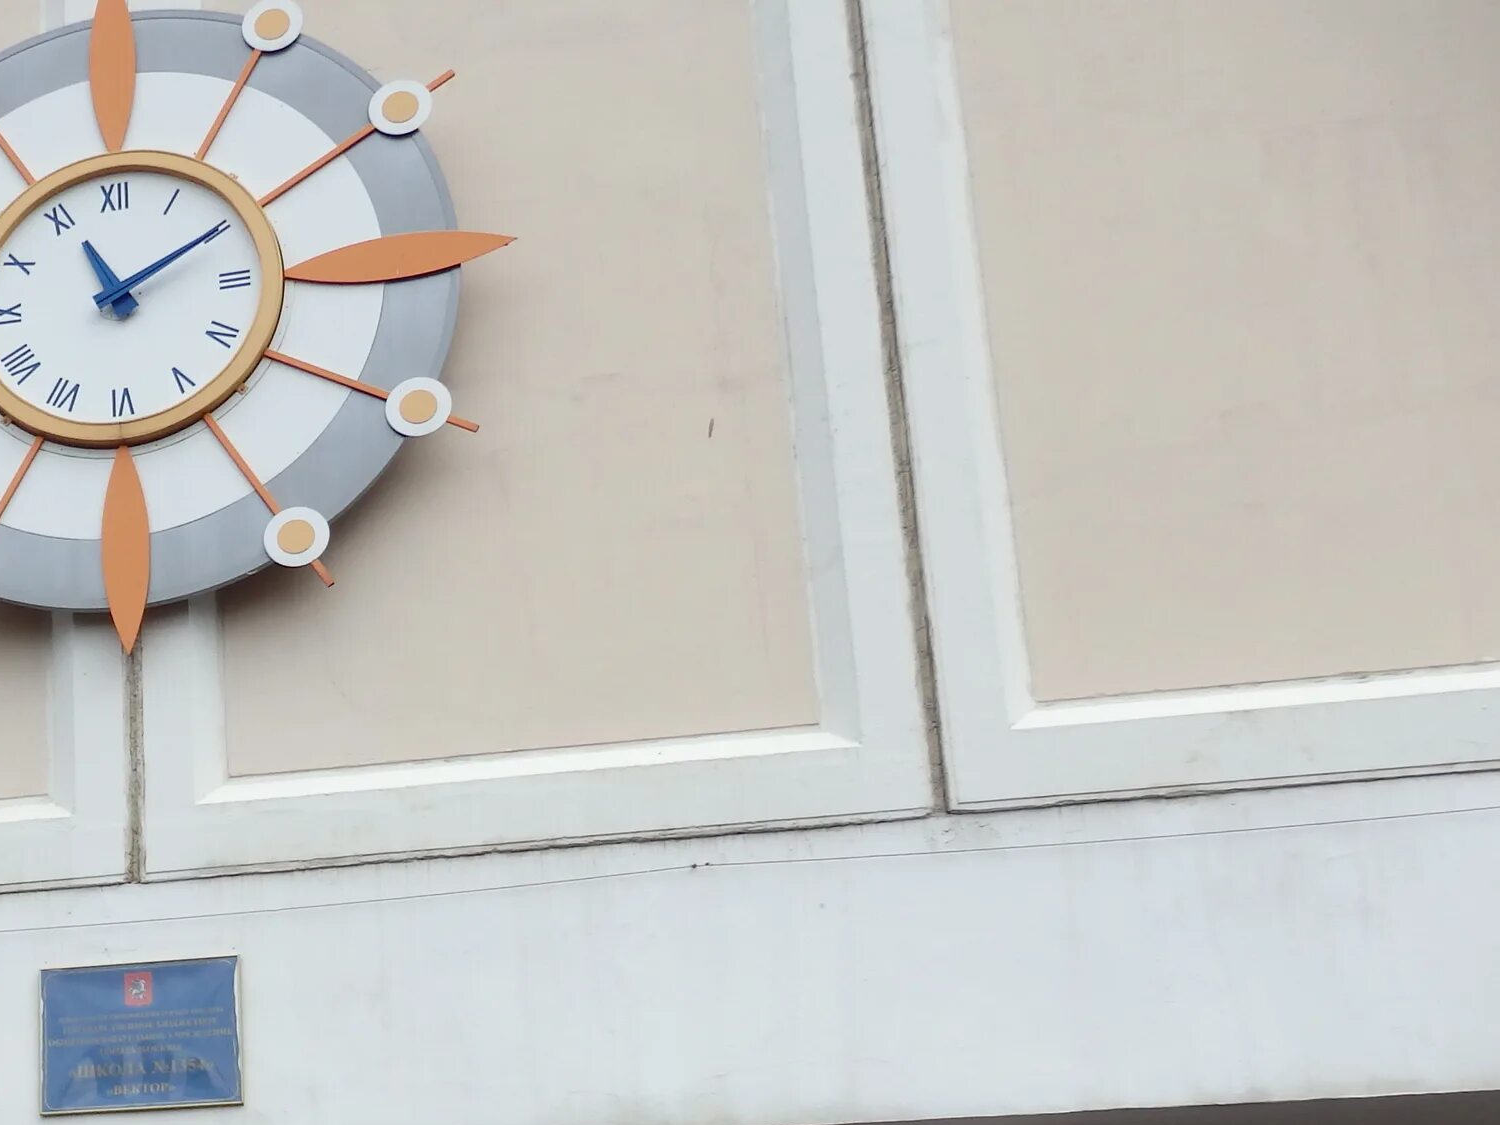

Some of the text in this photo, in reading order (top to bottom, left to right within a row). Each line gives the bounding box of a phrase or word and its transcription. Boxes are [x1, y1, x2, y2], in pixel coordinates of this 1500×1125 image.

[100, 181, 129, 213] XII
[44, 203, 75, 236] XI
[3, 253, 36, 275] X
[218, 269, 251, 290] III
[205, 321, 240, 348] IV
[1, 343, 41, 385] VIII
[46, 377, 80, 412] VII
[172, 367, 196, 394] V
[111, 387, 135, 418] VI
